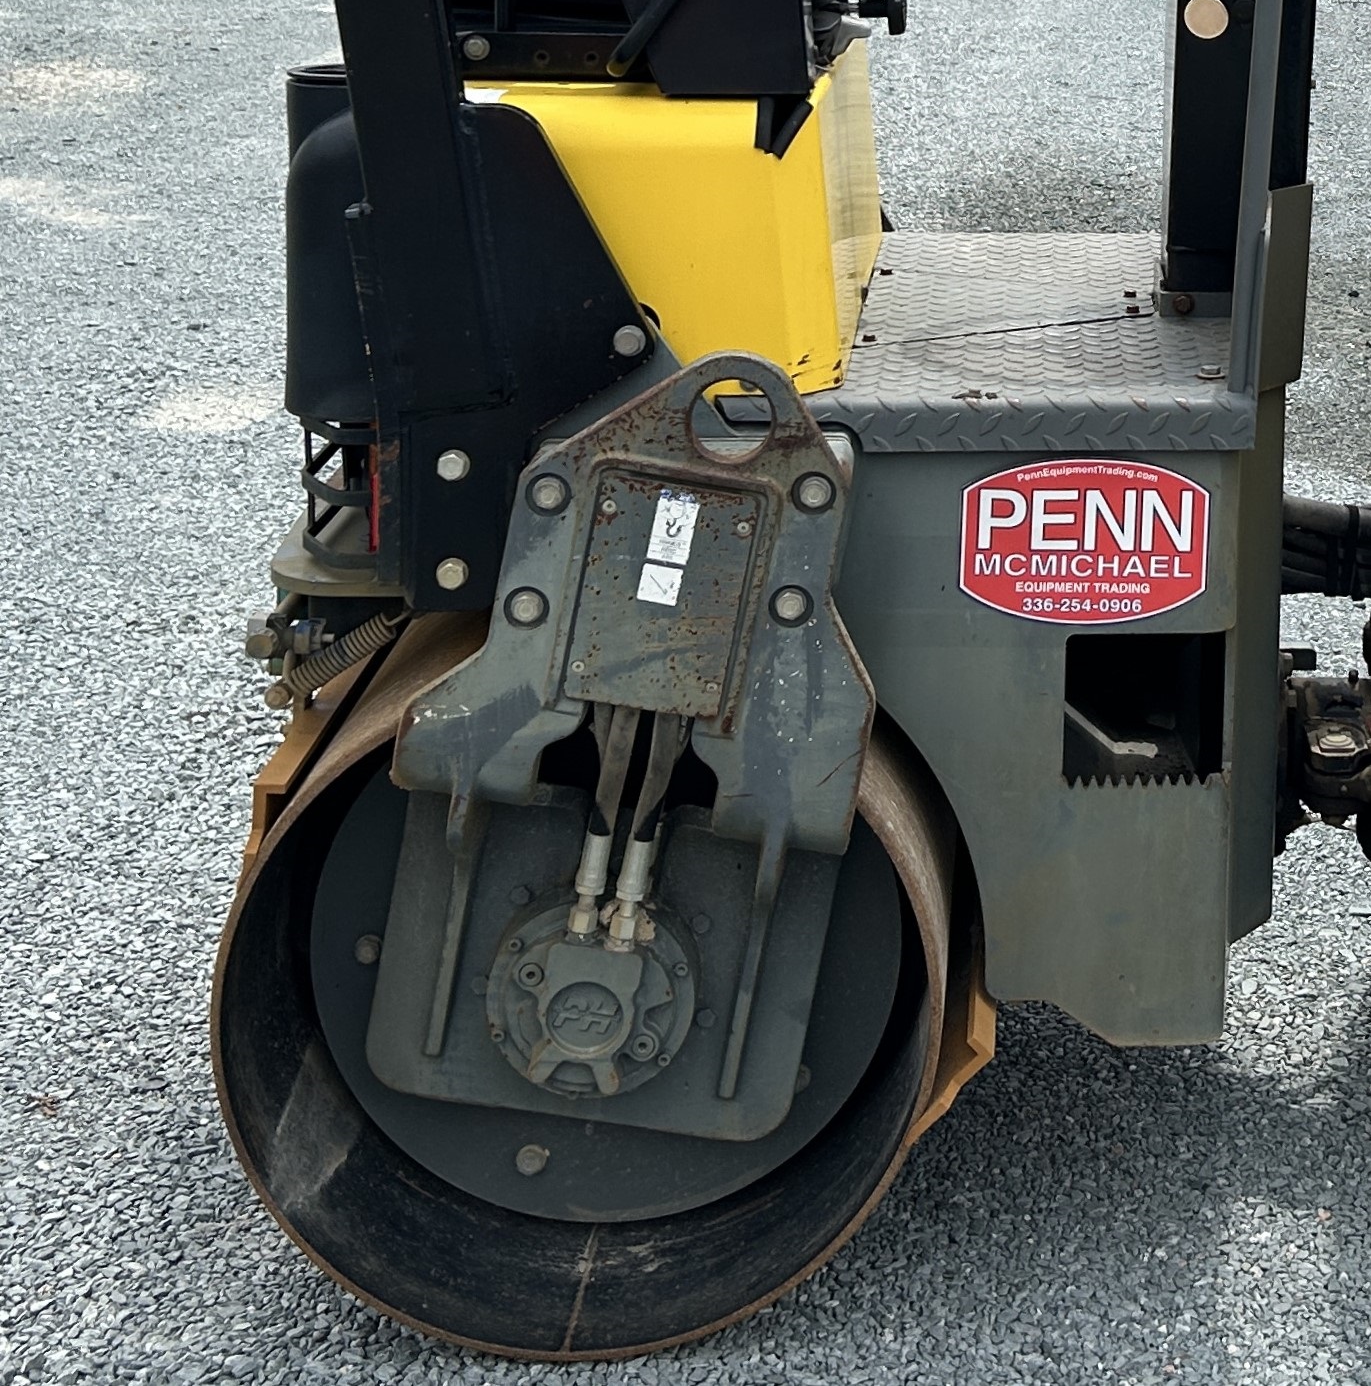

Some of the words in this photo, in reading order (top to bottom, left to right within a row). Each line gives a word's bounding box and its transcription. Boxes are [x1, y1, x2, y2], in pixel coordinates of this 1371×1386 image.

[1016, 464, 1159, 484] PennEquipmentTrading.com
[976, 488, 1194, 553] PENN
[973, 553, 1193, 579] MCMICHAEL
[1015, 581, 1091, 594] EQUIPMENT
[1093, 582, 1151, 595] TRADING
[1021, 597, 1143, 614] 336-254-0906
